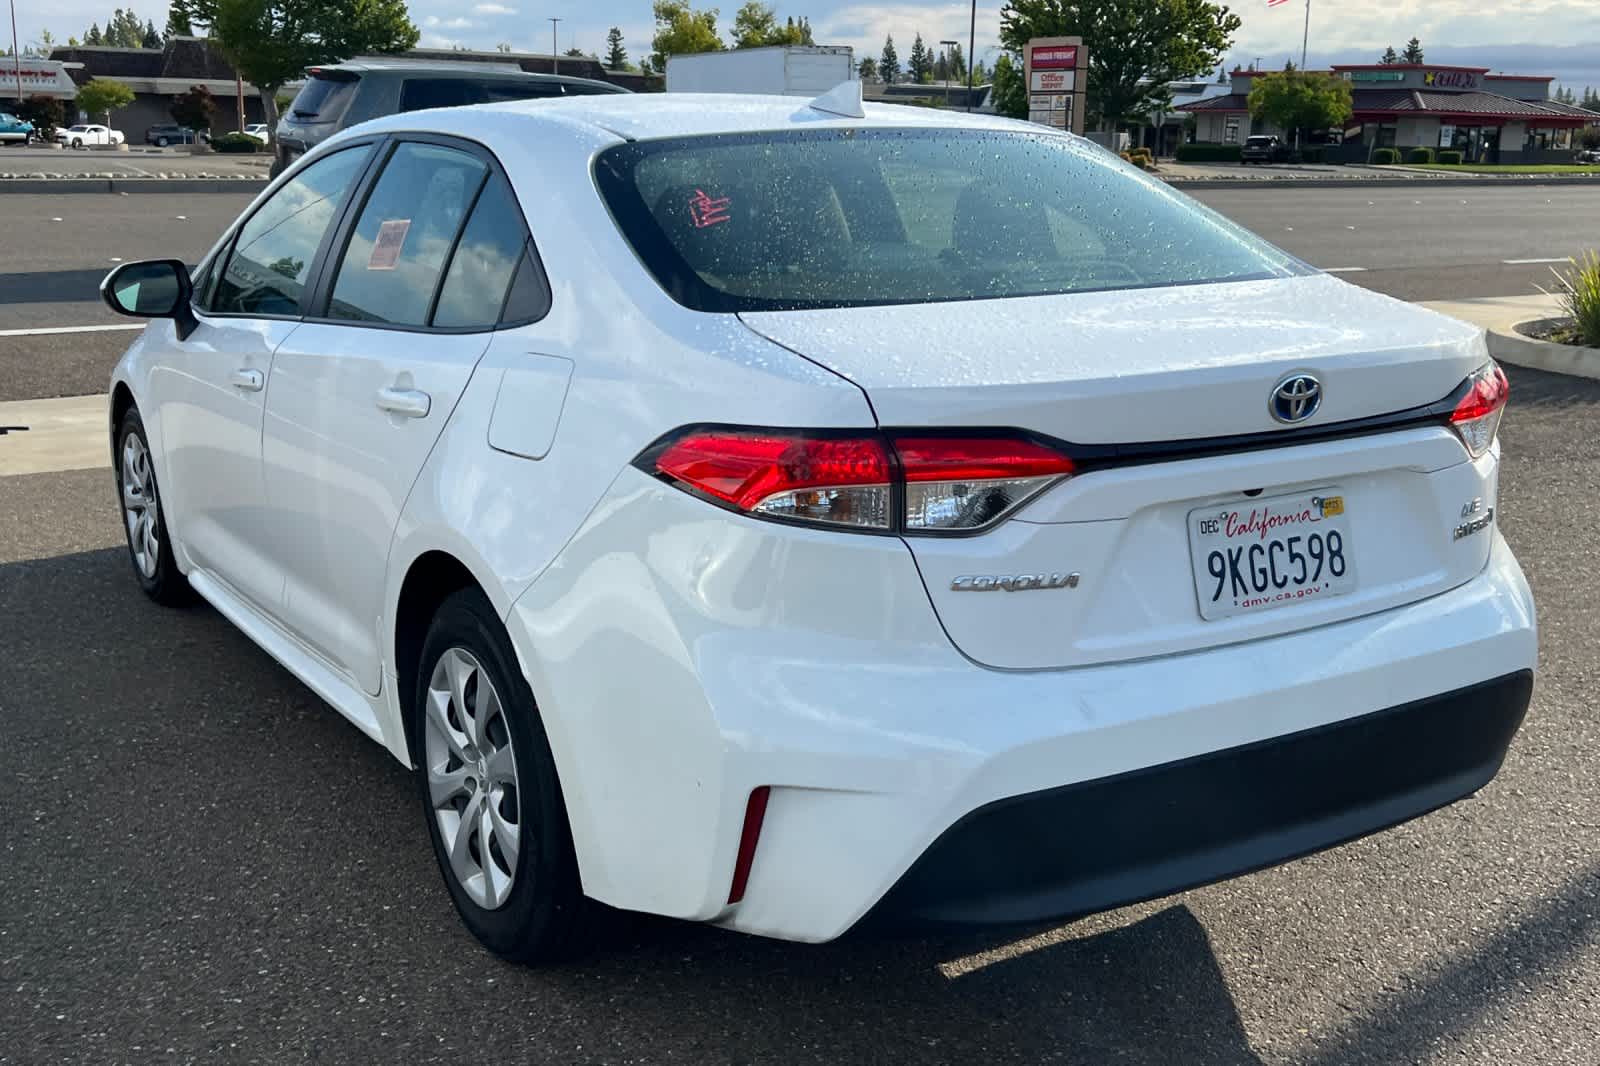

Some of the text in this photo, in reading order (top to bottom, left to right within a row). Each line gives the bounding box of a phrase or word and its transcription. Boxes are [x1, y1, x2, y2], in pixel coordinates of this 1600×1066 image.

[1041, 73, 1065, 81] Office
[1200, 518, 1220, 535] DEC
[1225, 507, 1321, 540] California
[1207, 530, 1346, 602] 9KGC598
[950, 571, 1081, 592] COROLLA
[1242, 585, 1321, 608] dmv.ca.gov
